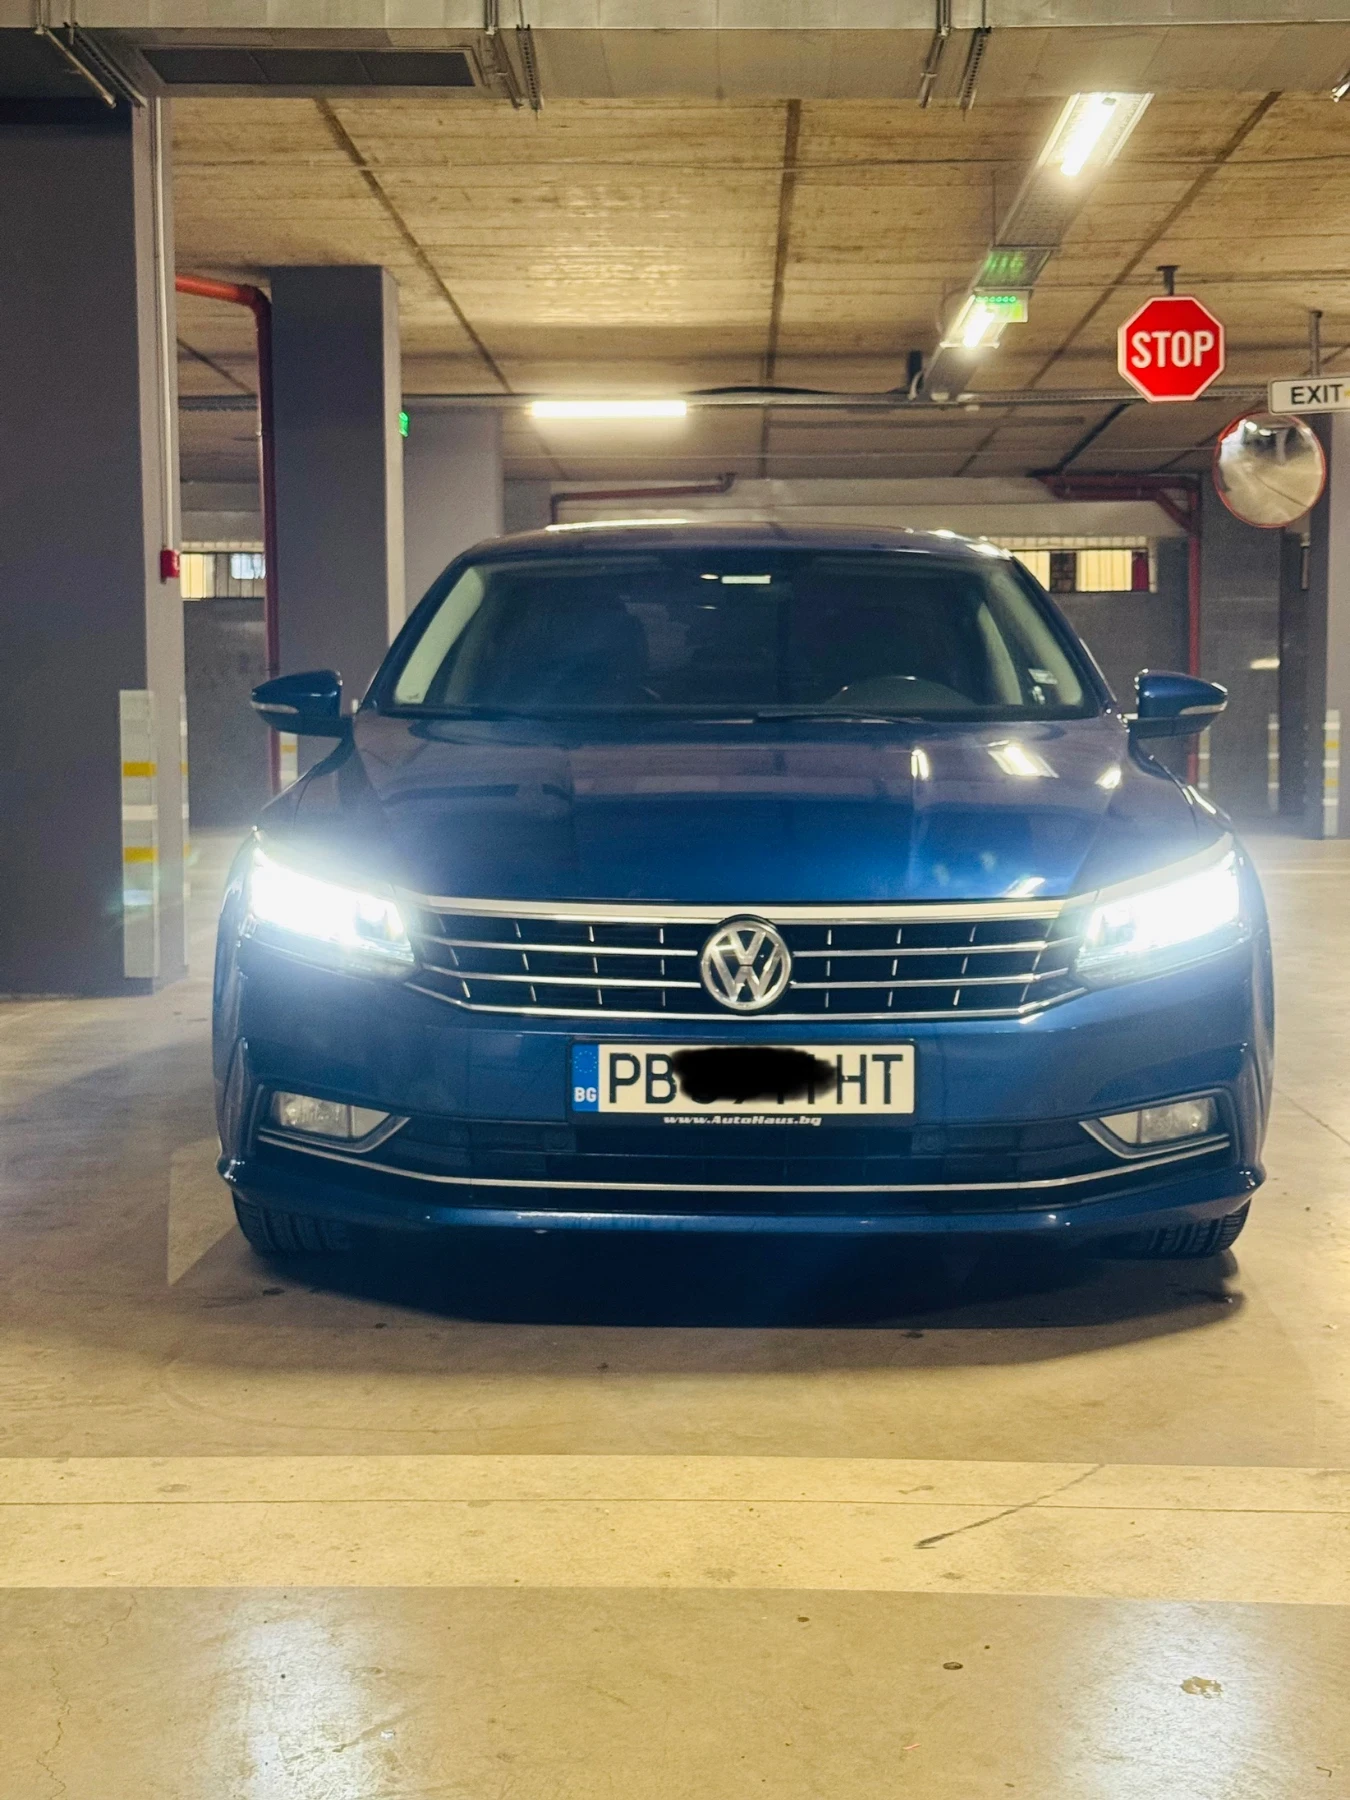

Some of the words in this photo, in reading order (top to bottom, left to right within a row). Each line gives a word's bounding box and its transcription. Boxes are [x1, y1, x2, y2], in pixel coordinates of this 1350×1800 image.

[1131, 330, 1215, 369] STOP
[1291, 384, 1343, 405] EXIT
[705, 925, 787, 1006] VW
[608, 1053, 677, 1104] PB
[836, 1054, 903, 1104] HT
[574, 1087, 597, 1103] BG
[663, 1115, 822, 1127] www.AutoHaus.bg
